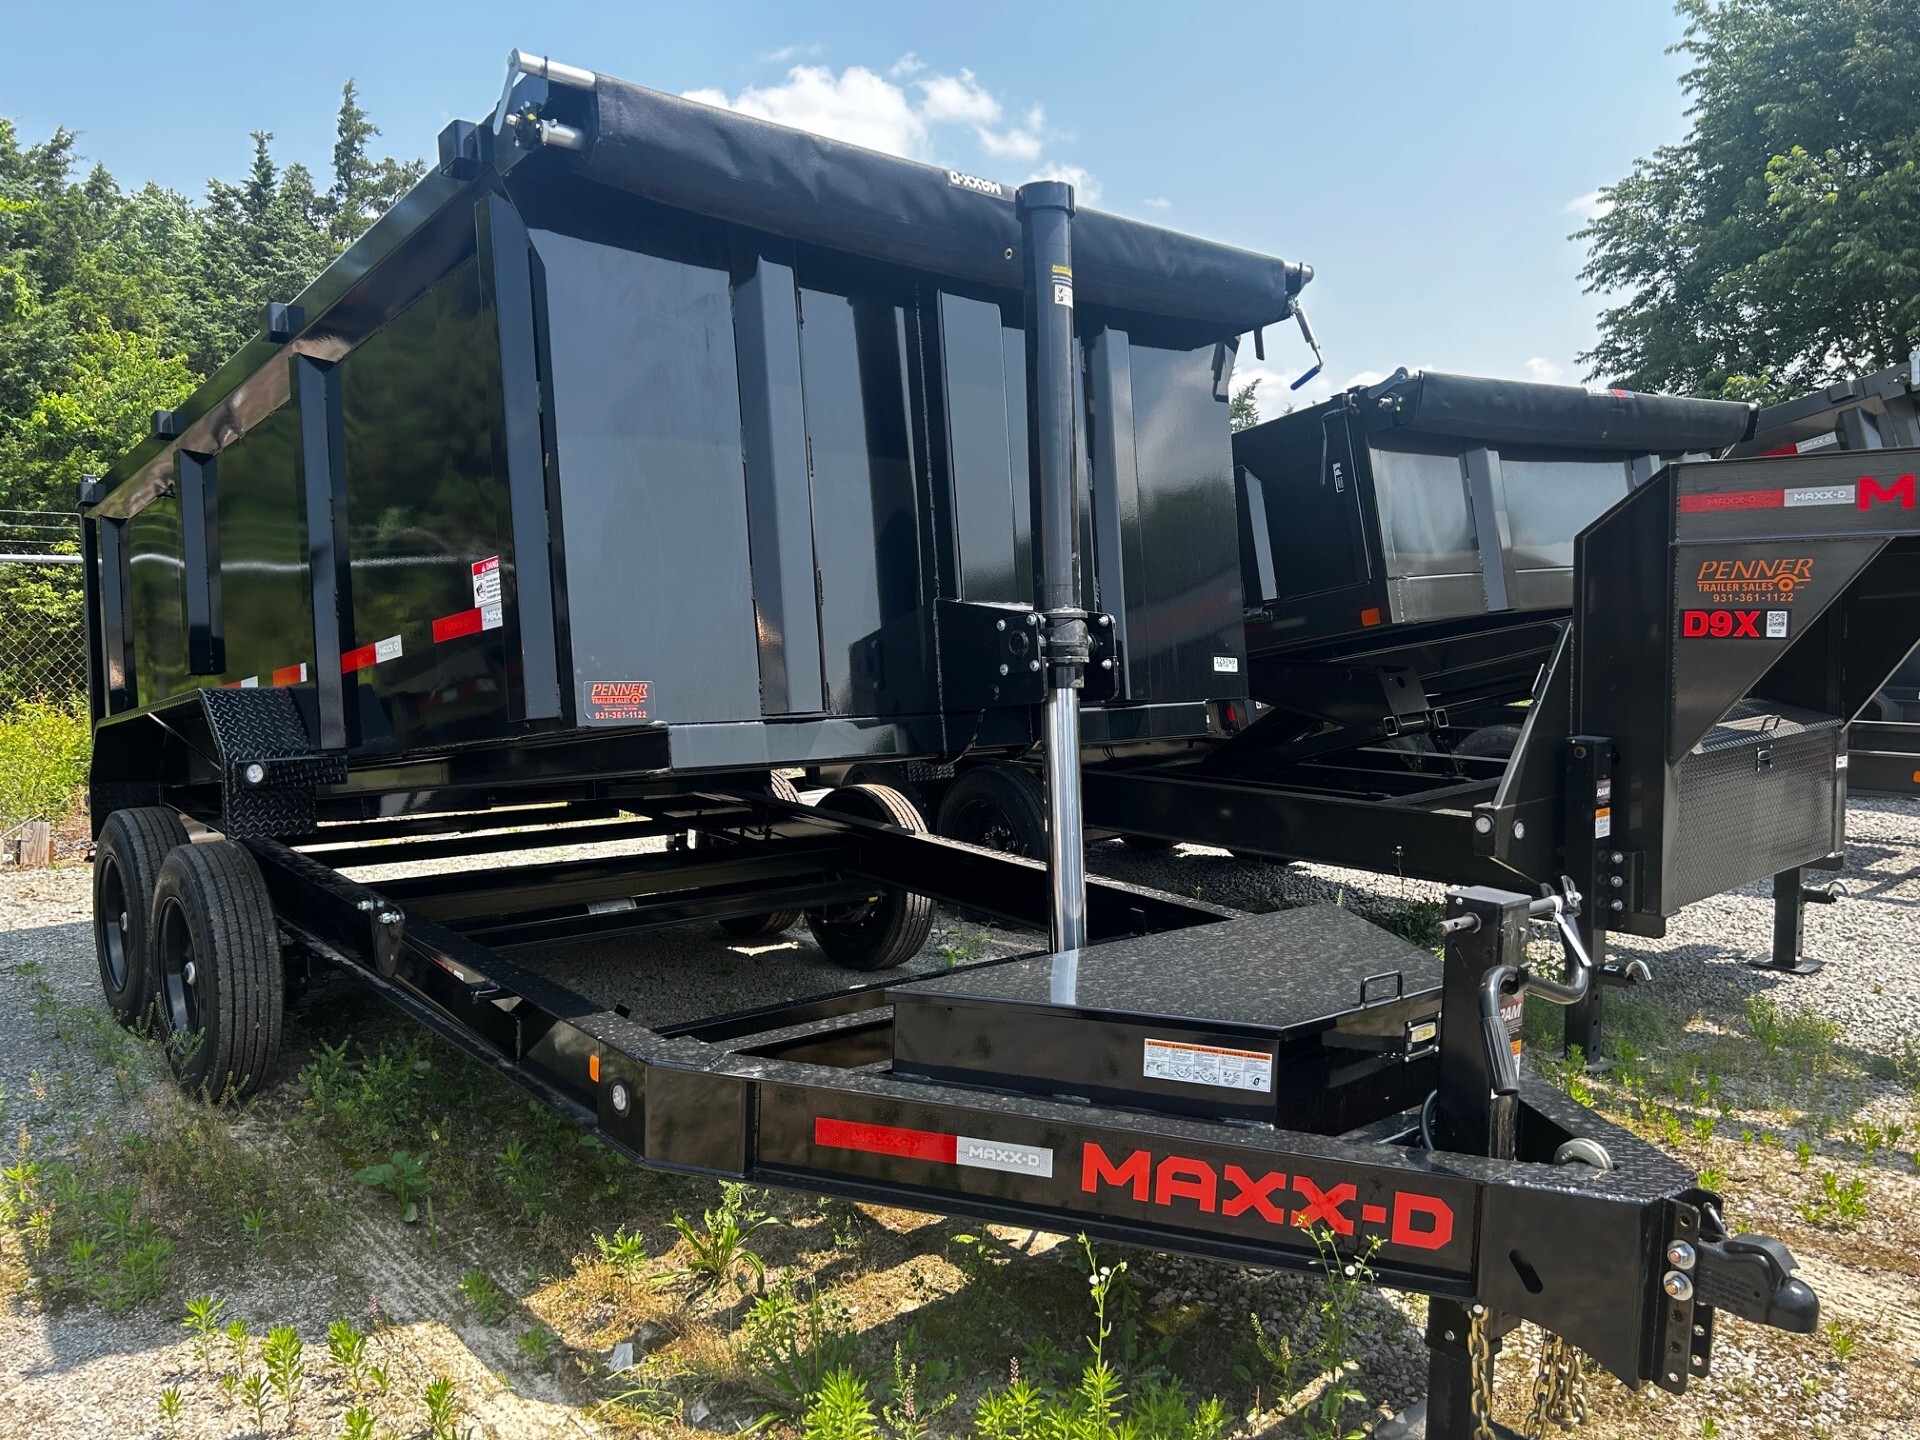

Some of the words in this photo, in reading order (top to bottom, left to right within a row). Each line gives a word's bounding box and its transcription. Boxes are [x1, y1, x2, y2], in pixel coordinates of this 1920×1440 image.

[1793, 490, 1847, 501] MAXX-D
[1697, 558, 1814, 579] PENNER
[1697, 583, 1739, 592] TRAILER
[1742, 582, 1774, 592] SALES
[1713, 592, 1794, 603] 931-361-1122
[1683, 610, 1761, 637] D9X
[591, 683, 648, 696] PENNER
[594, 711, 647, 719] 931-361-1122
[968, 1145, 1040, 1167] MAXX-D
[1082, 1142, 1454, 1250] MAXX-D
